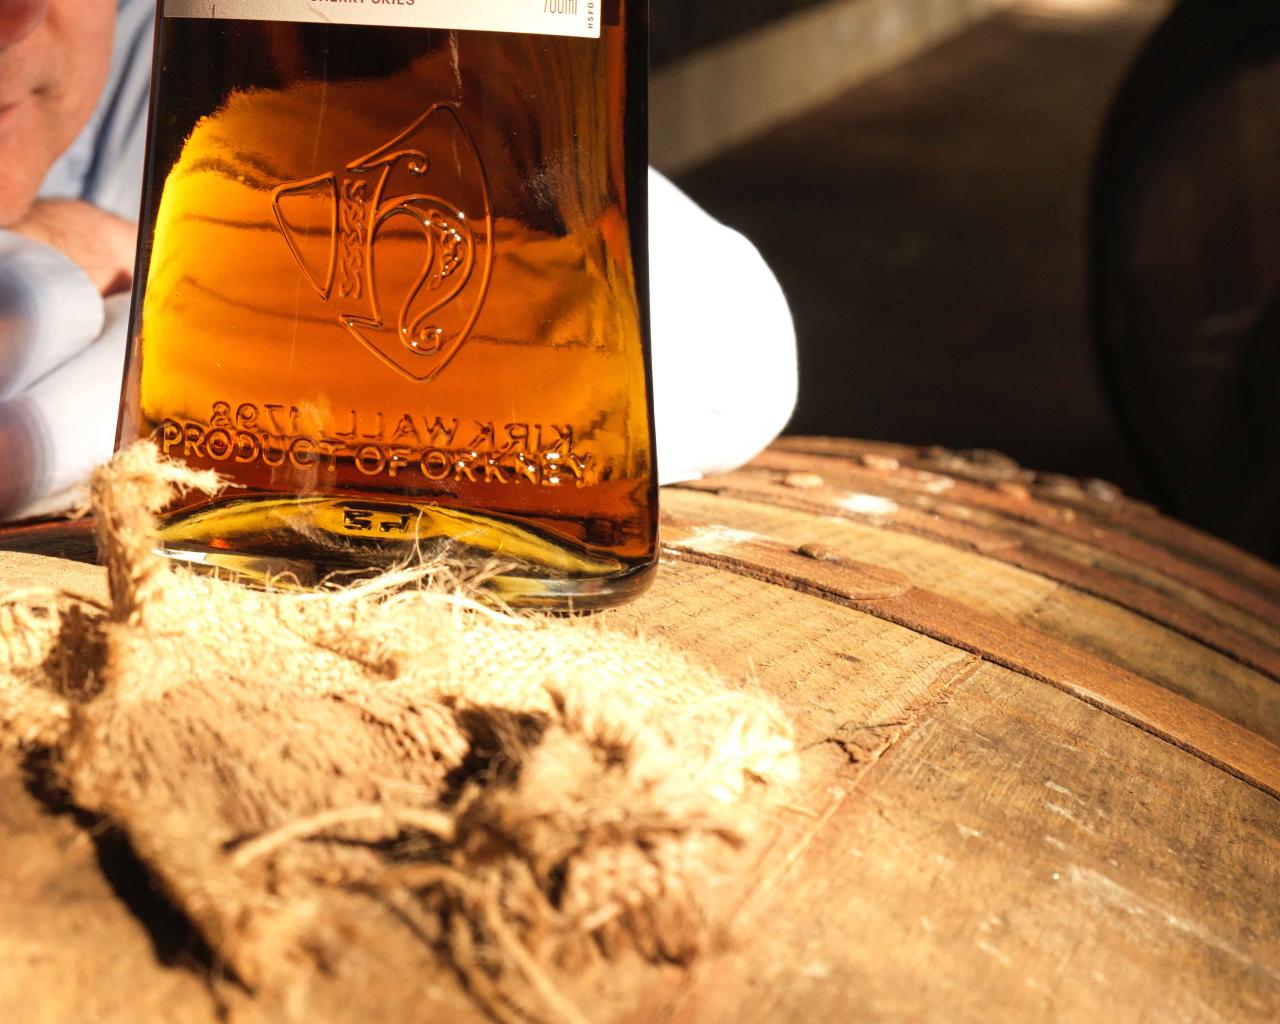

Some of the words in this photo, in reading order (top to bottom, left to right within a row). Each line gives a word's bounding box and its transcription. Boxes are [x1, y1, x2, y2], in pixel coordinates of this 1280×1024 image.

[162, 418, 348, 472] PRODUCT
[355, 442, 413, 477] OF
[420, 445, 594, 490] ORKNEY
